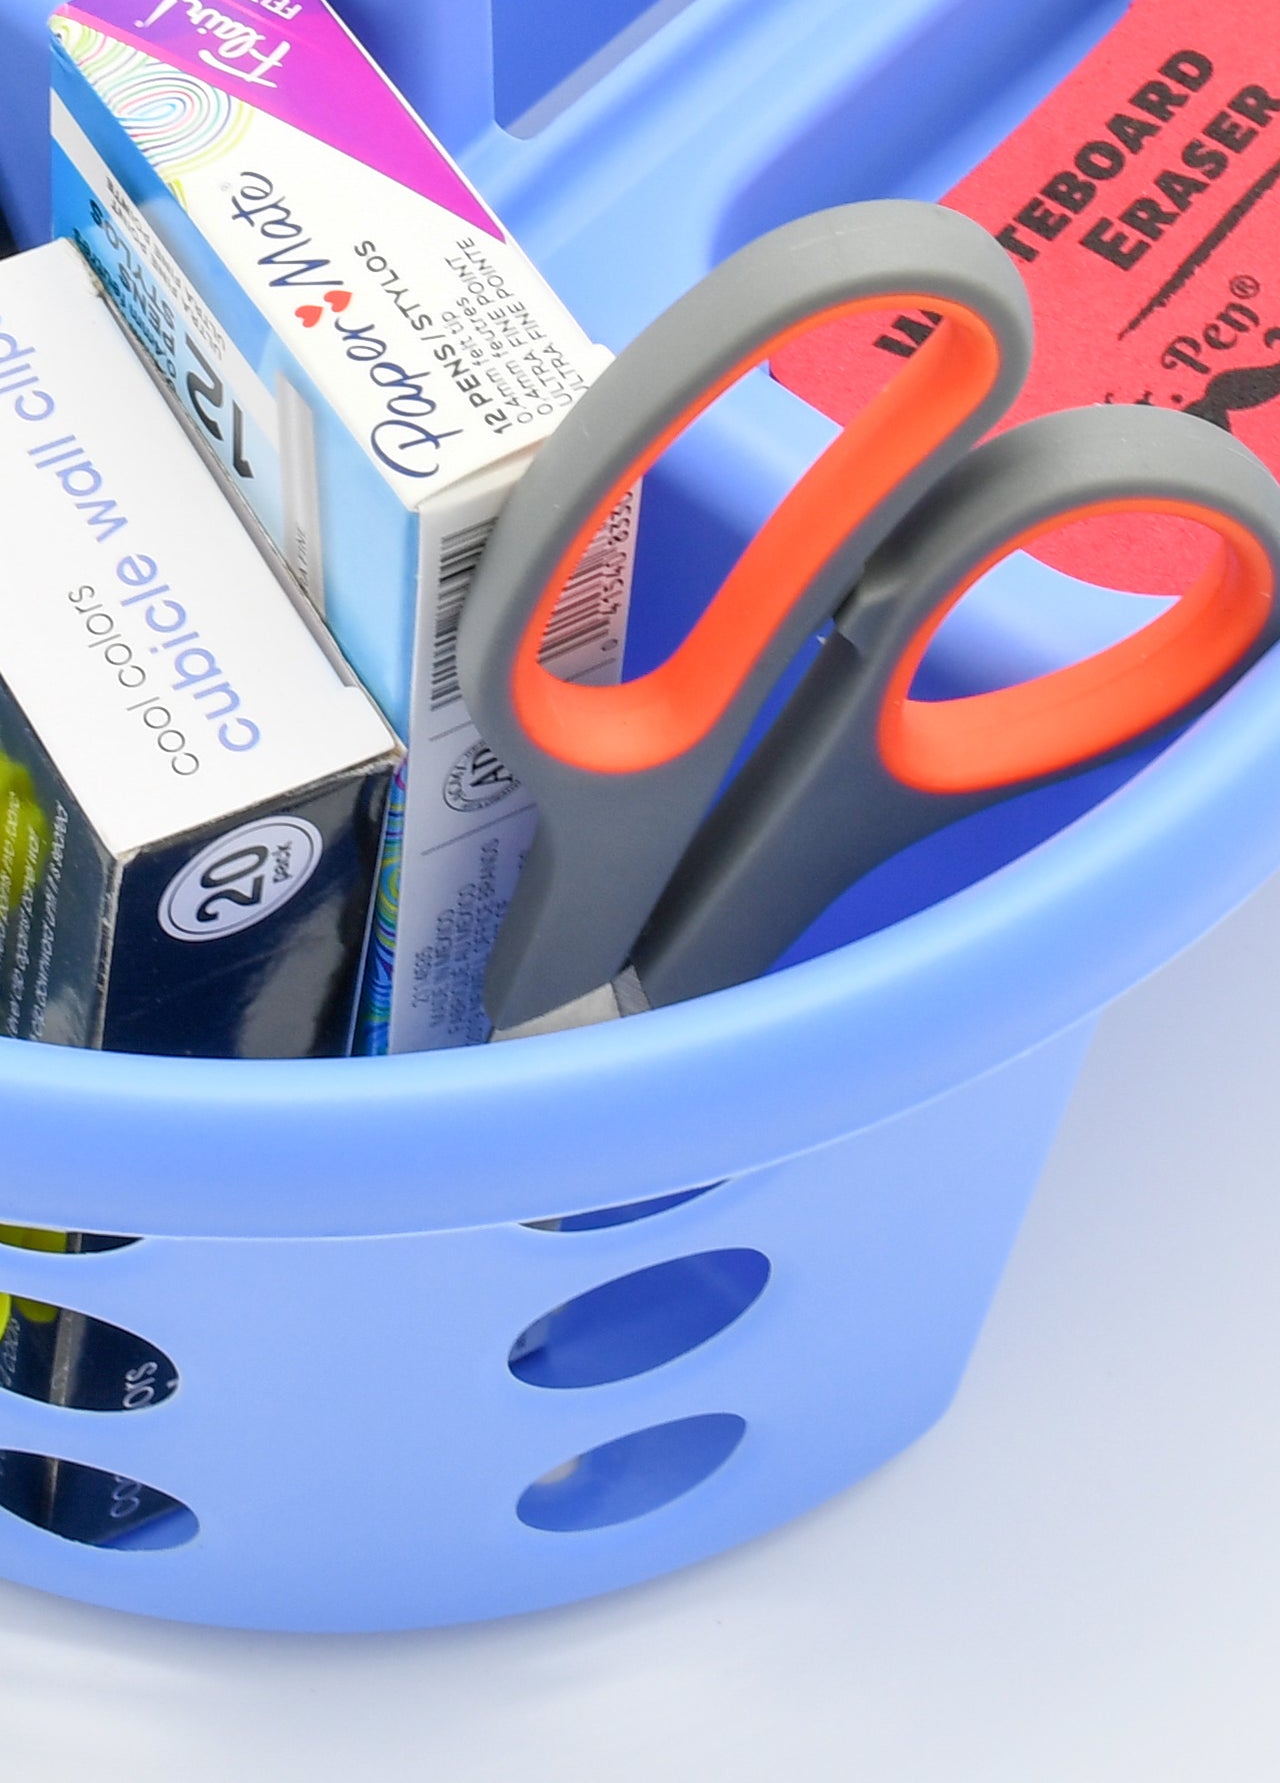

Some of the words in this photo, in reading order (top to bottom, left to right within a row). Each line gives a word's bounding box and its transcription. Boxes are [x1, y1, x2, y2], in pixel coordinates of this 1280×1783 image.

[89, 199, 176, 330] STYLOS
[231, 171, 344, 287] Mate
[456, 236, 516, 301] POINTE
[118, 262, 176, 356] PENS
[354, 240, 433, 331] STYLOS
[444, 256, 495, 307] POINT
[508, 301, 548, 341] FINE
[487, 307, 525, 349] FINE
[185, 331, 254, 478] 12
[334, 317, 464, 479] Paper
[433, 344, 493, 408] PENS
[523, 348, 573, 408] ULTRA
[484, 408, 513, 435] 12
[27, 434, 129, 543] wall
[68, 585, 147, 688] colors
[116, 553, 261, 753] cubicle
[127, 696, 200, 776] cool
[197, 845, 270, 923] 20
